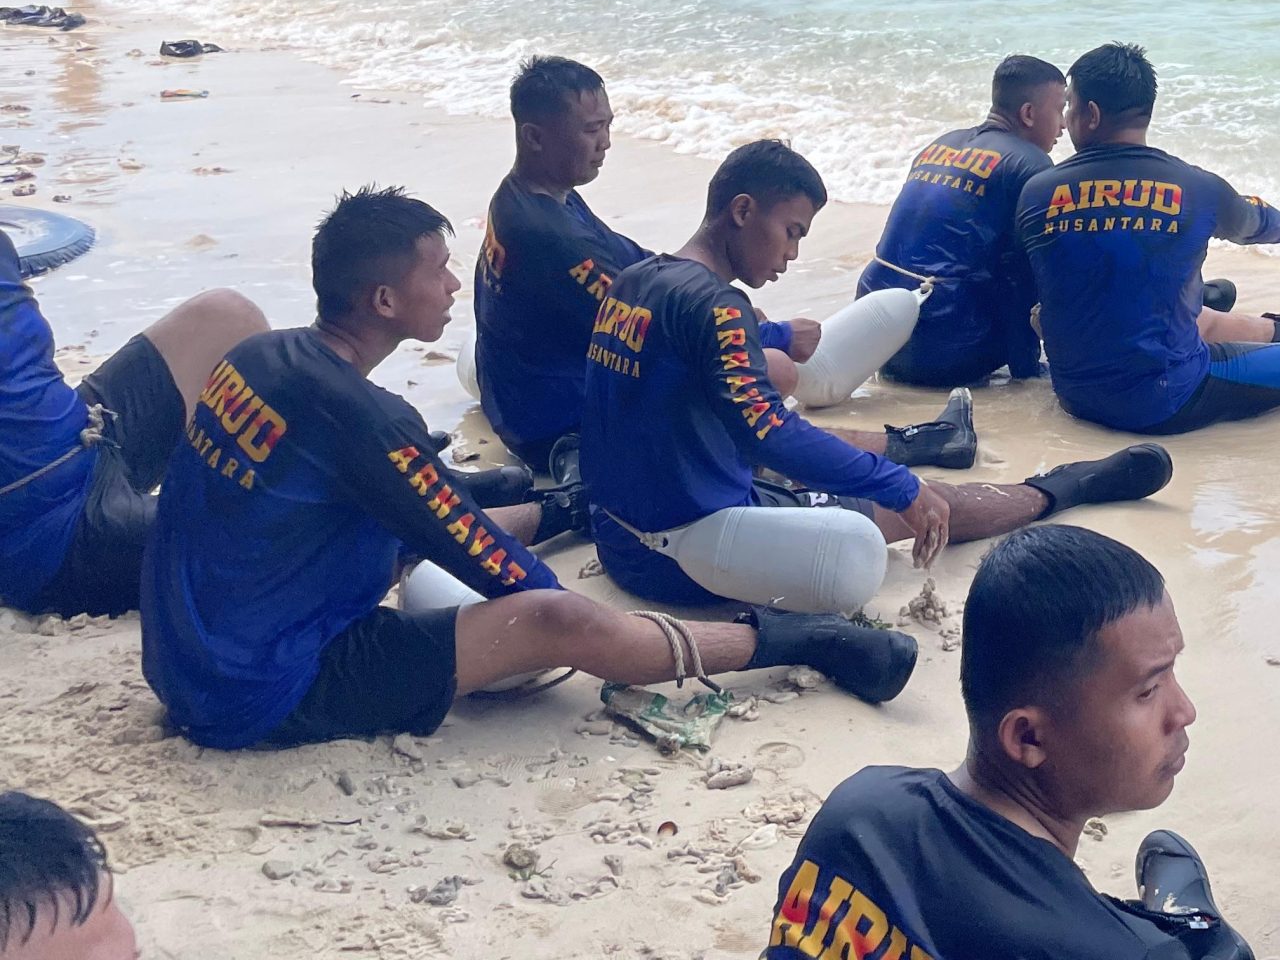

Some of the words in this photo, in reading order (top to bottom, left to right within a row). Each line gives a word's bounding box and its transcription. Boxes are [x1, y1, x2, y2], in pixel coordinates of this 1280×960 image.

[913, 143, 1002, 179] AIRUD
[908, 169, 986, 197] SANTARA
[1045, 179, 1183, 218] AIRUD
[1044, 217, 1179, 234] NUSANTARA
[387, 445, 527, 586] ARNAVAT
[768, 859, 936, 960] AIR
